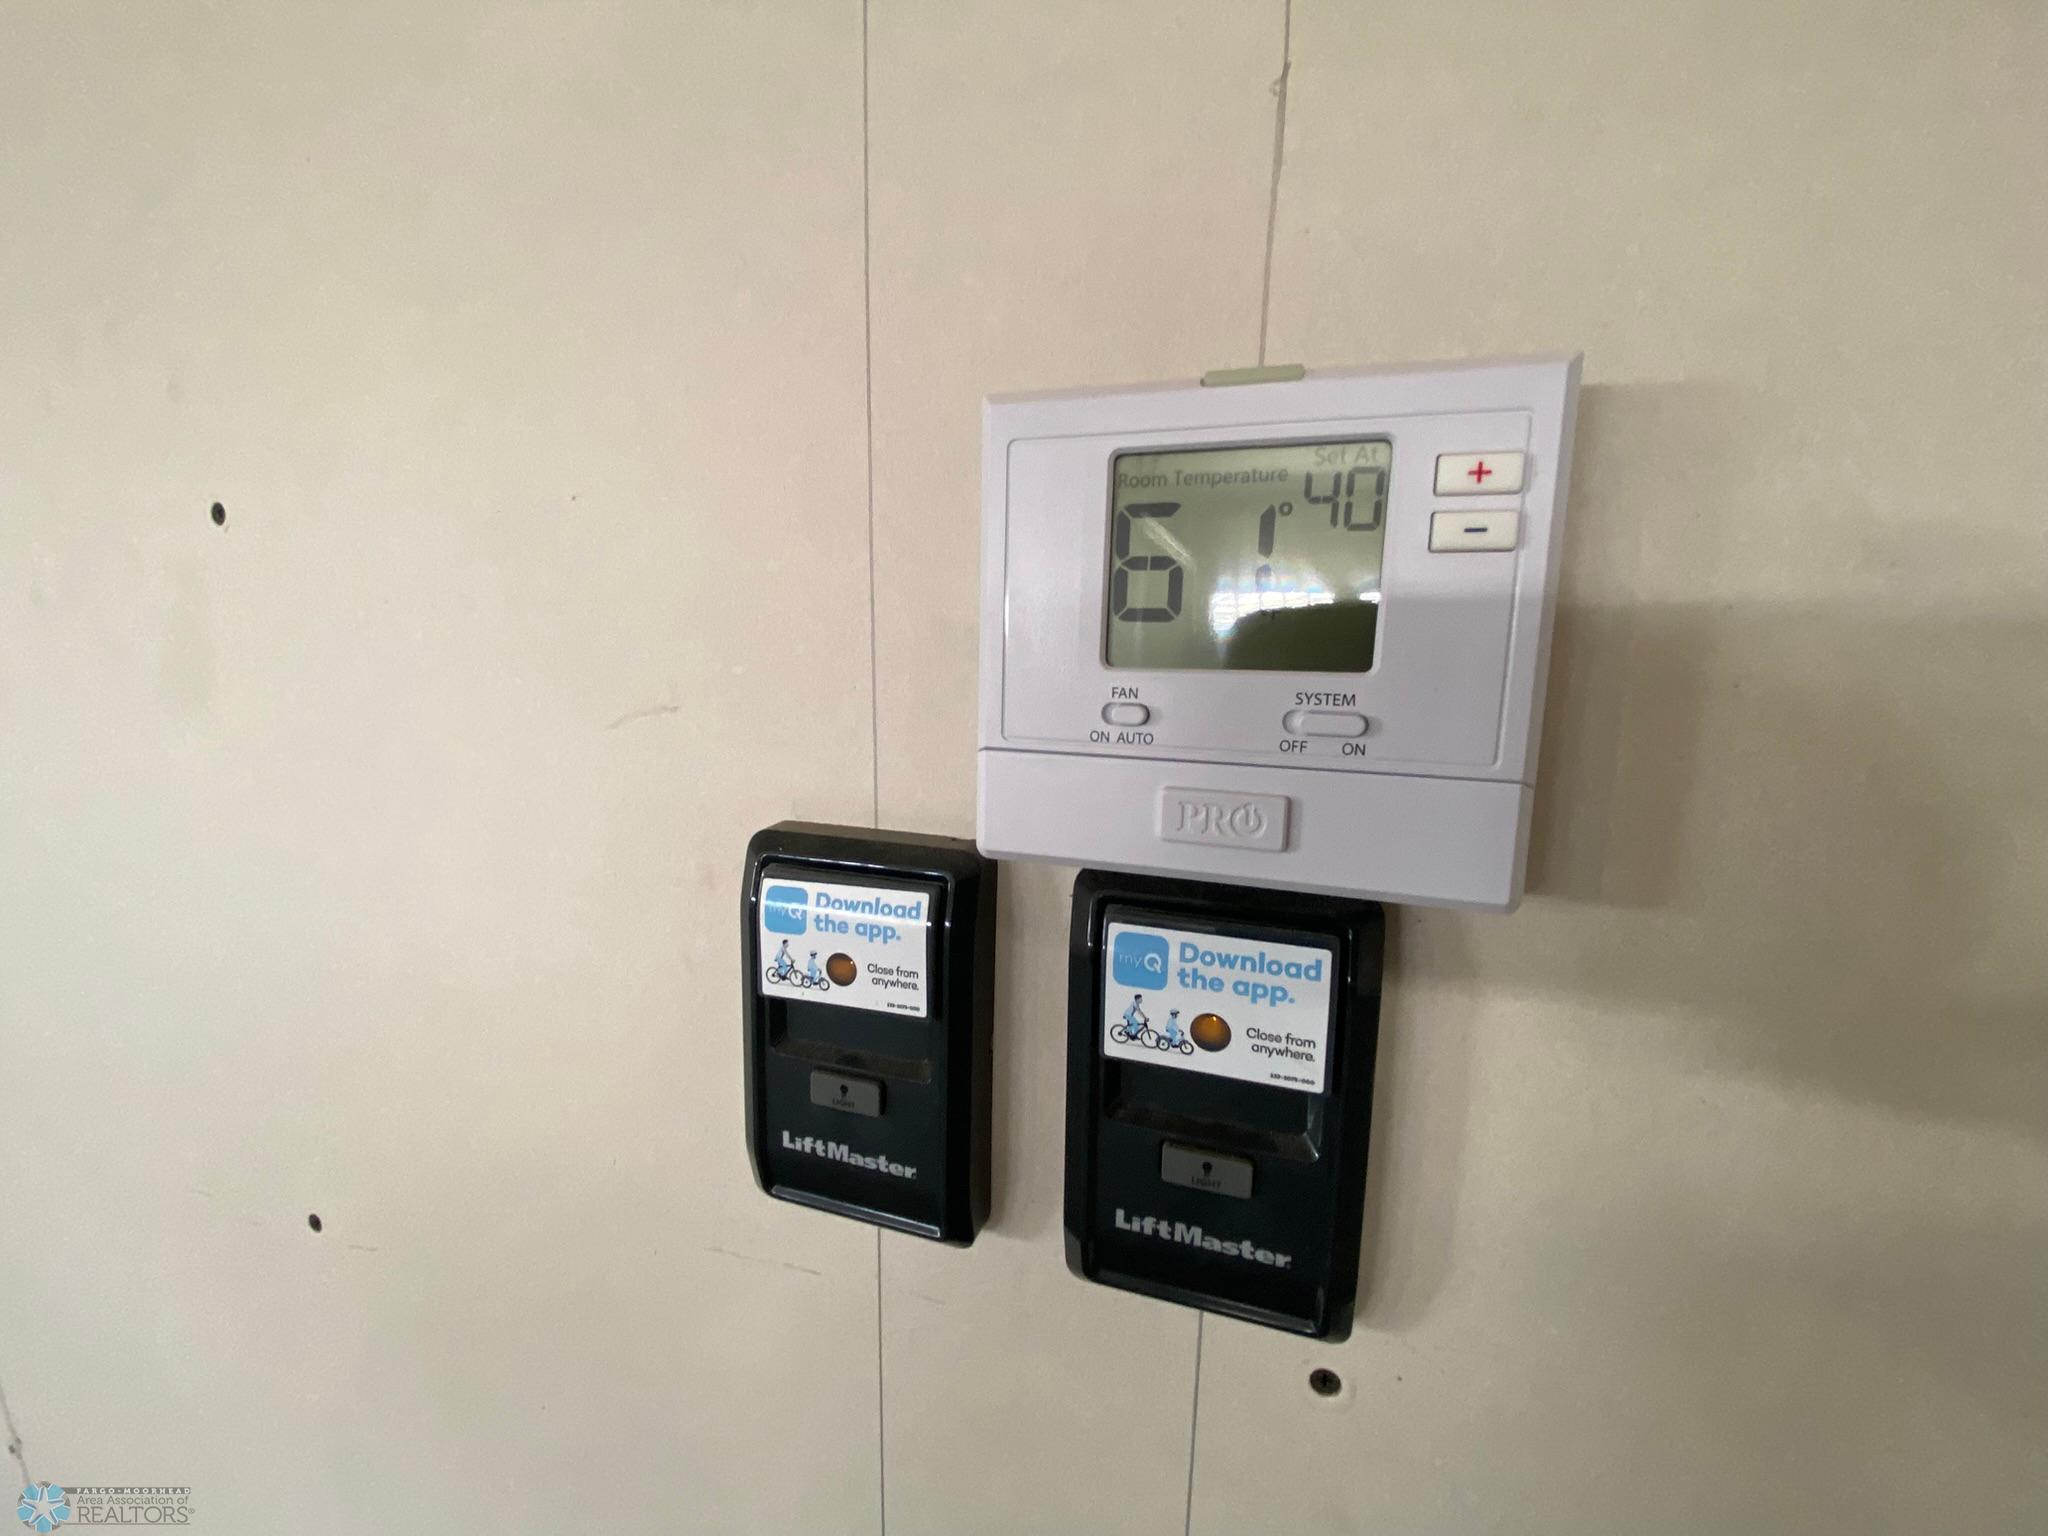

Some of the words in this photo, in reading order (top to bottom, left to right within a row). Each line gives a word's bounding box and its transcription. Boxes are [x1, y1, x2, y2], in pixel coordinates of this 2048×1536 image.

[1314, 446, 1347, 466] Set
[1354, 446, 1379, 463] At
[1118, 472, 1167, 488] Room
[1175, 467, 1289, 487] Temperature
[1304, 466, 1386, 531] 40
[1111, 687, 1139, 699] FAN
[1295, 692, 1356, 707] SYSTEM
[1090, 731, 1110, 743] ON
[1117, 732, 1154, 745] AUTO
[1279, 740, 1308, 753] OFF
[1341, 743, 1366, 756] ON
[815, 892, 922, 921] Download
[813, 914, 849, 935] the
[854, 922, 902, 944] app.
[866, 963, 894, 976] Close
[897, 966, 919, 979] from
[1119, 953, 1163, 974] myQ
[1178, 942, 1322, 982] Download
[872, 977, 919, 991] anywhere.
[1177, 968, 1225, 992] the
[1232, 980, 1296, 1008] app.
[1246, 1028, 1282, 1043] Close
[1285, 1033, 1316, 1049] from
[1251, 1043, 1316, 1063] anywhere.
[782, 1130, 917, 1179] LiftMaster
[1115, 1208, 1292, 1269] LiftMaster
